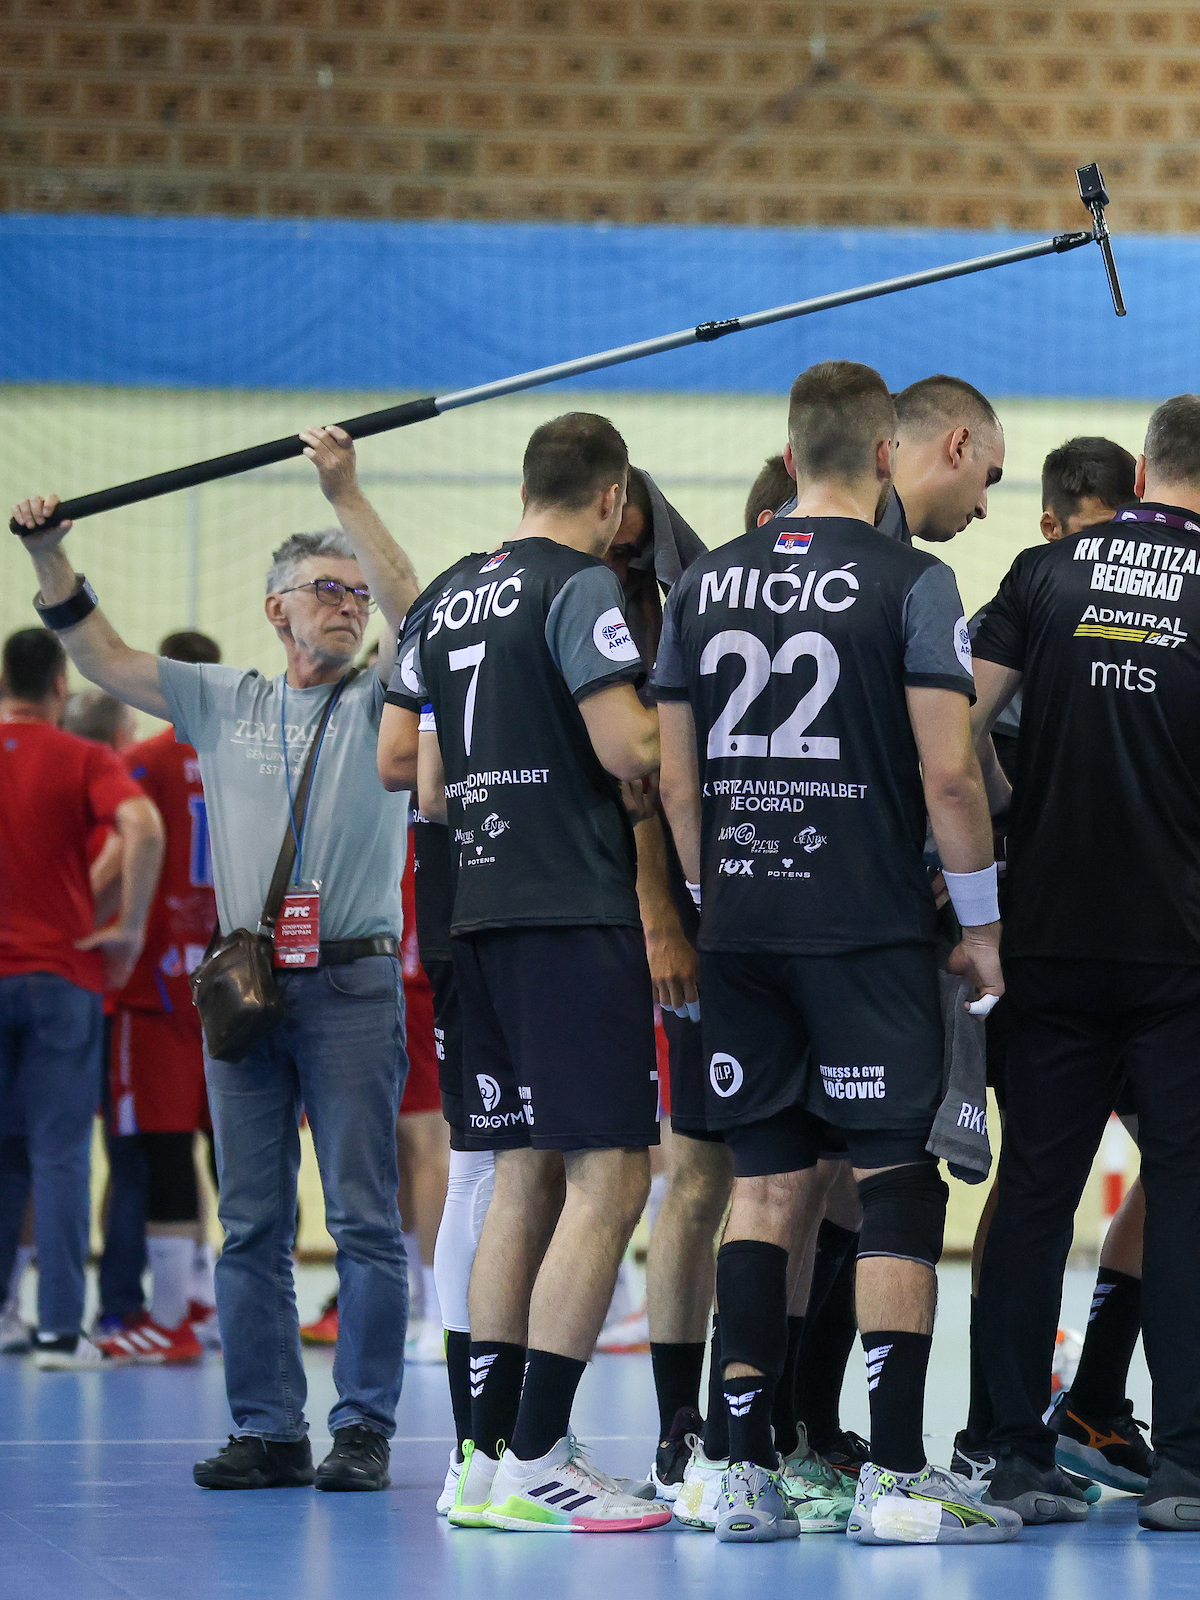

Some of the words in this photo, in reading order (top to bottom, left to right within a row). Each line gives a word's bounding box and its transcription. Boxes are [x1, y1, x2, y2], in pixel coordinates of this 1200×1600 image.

[1073, 537, 1106, 561] RK
[698, 562, 860, 616] MIĆIĆ
[1090, 562, 1184, 603] BEOGRAD
[427, 568, 526, 641] ŠOTIĆ
[1080, 604, 1188, 638] ADMIRAL
[608, 634, 632, 650] ARK
[1144, 632, 1187, 650] BET
[1090, 658, 1159, 694] mts
[447, 639, 487, 758] 7
[700, 629, 841, 761] 22
[466, 768, 550, 789] DMIRALBET
[768, 779, 868, 800] ADMIRALBET
[730, 796, 805, 814] BEOGRAD
[467, 856, 496, 867] POTENS
[767, 870, 812, 879] POTENS
[819, 1064, 851, 1079] FITNESS
[851, 1065, 861, 1078] &
[861, 1065, 885, 1079] GYM
